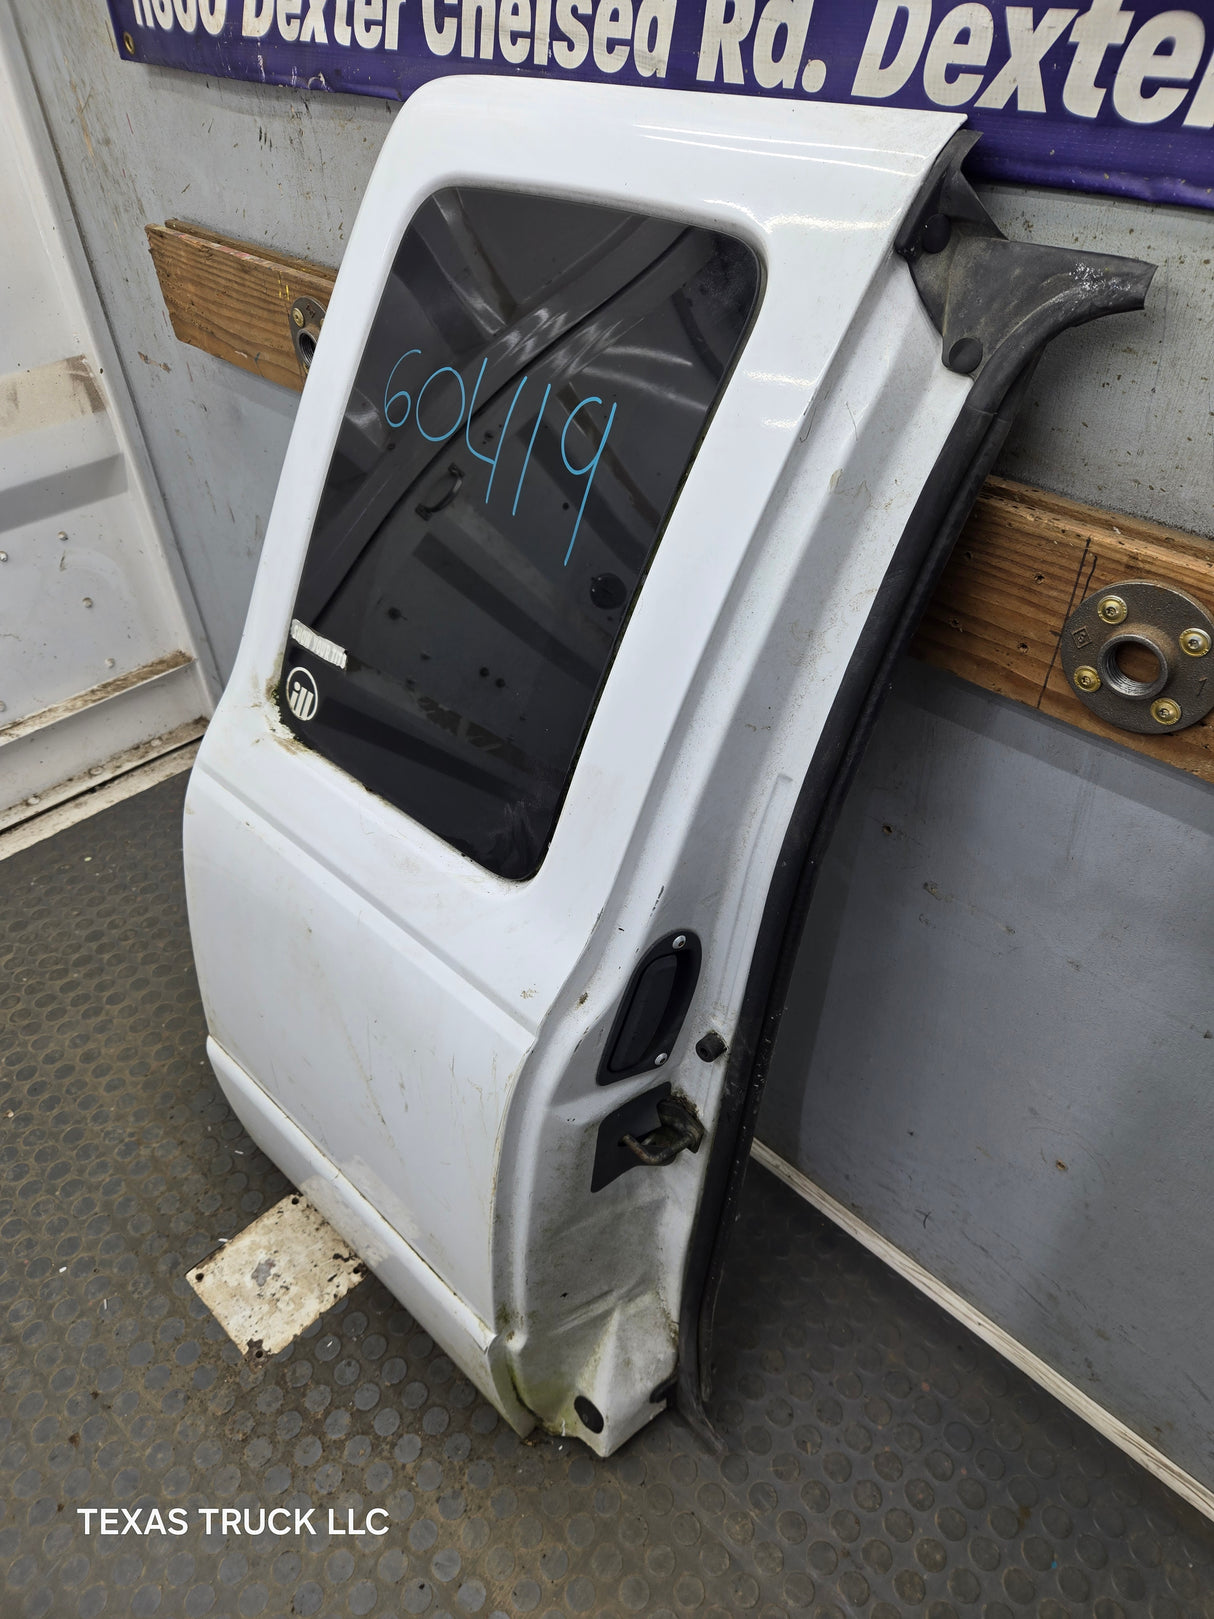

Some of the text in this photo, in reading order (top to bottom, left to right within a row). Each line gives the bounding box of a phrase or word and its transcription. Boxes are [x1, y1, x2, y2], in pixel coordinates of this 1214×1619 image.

[241, 0, 406, 51] Dexter
[421, 0, 675, 79] Chelsea
[696, 0, 827, 93] Rd.
[384, 348, 617, 567] 60419
